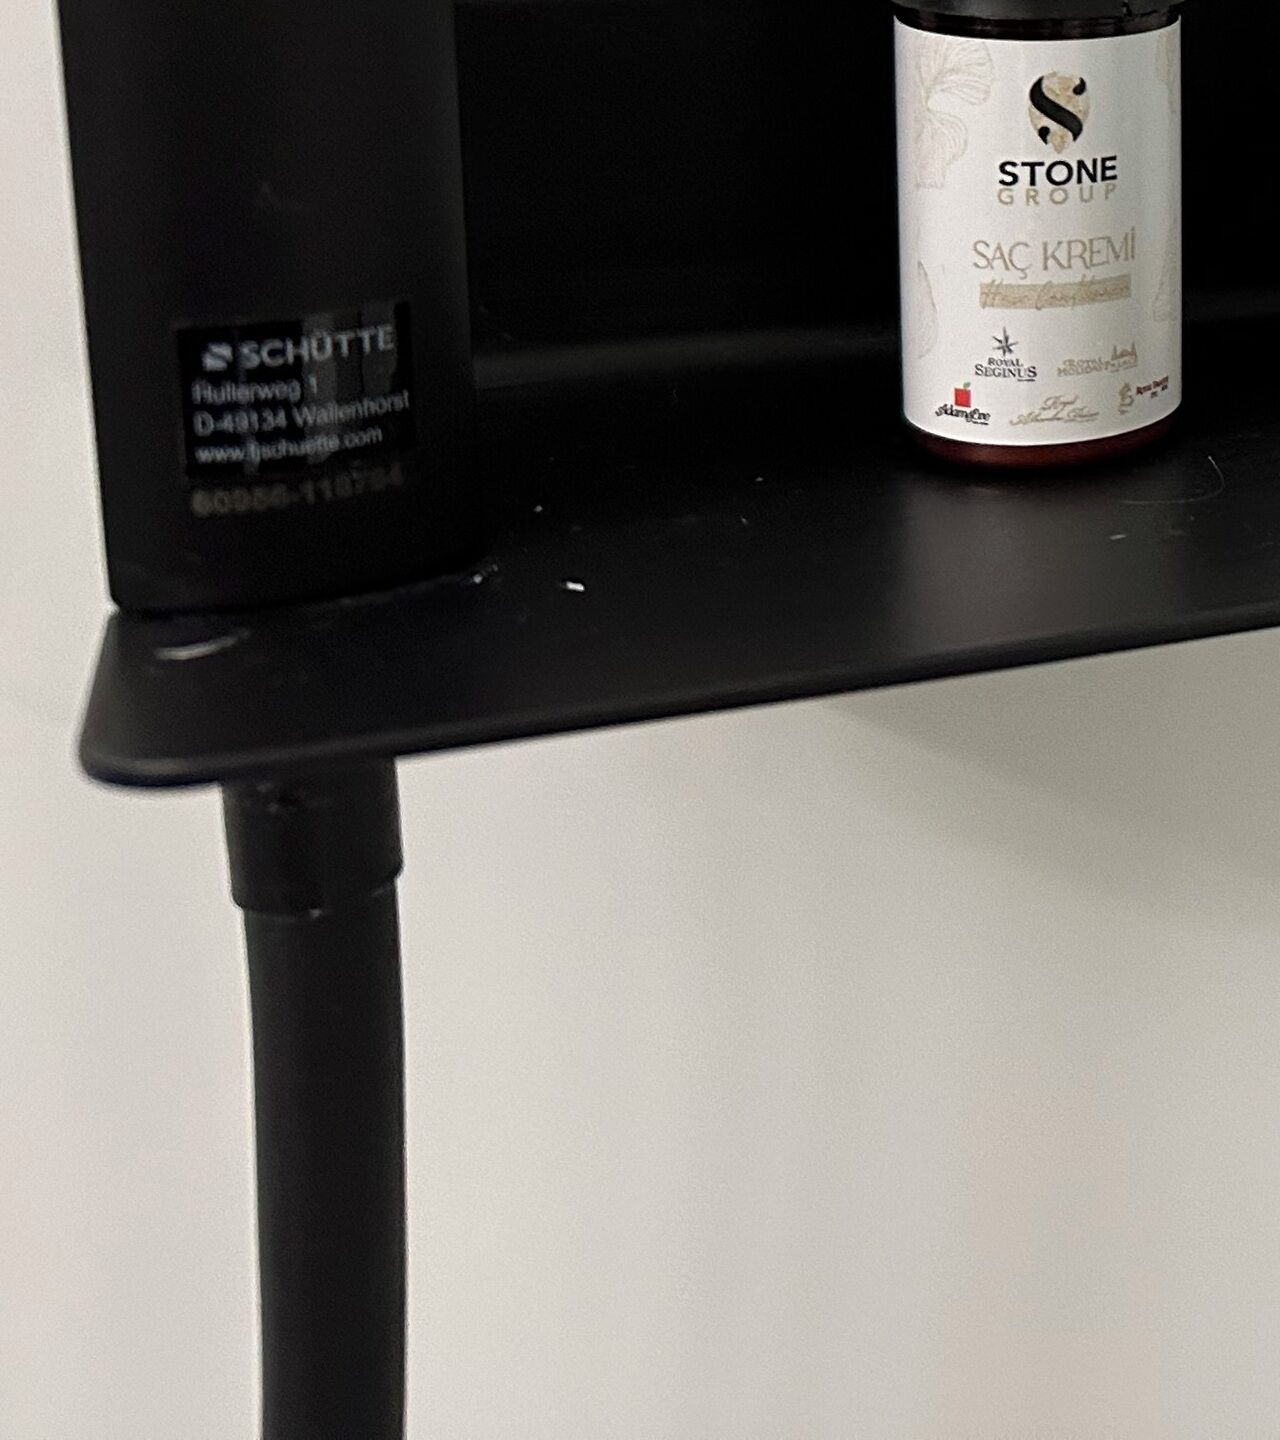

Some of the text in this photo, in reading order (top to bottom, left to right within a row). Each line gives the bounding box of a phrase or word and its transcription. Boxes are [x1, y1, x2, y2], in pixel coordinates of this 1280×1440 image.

[997, 155, 1119, 188] STONE
[997, 182, 1119, 206] GROUP
[971, 226, 1137, 280] SAÇ KREMİ
[238, 323, 396, 370] SCHÜTTE
[974, 363, 1038, 379] SEGINUS
[987, 357, 1024, 368] ROYAL
